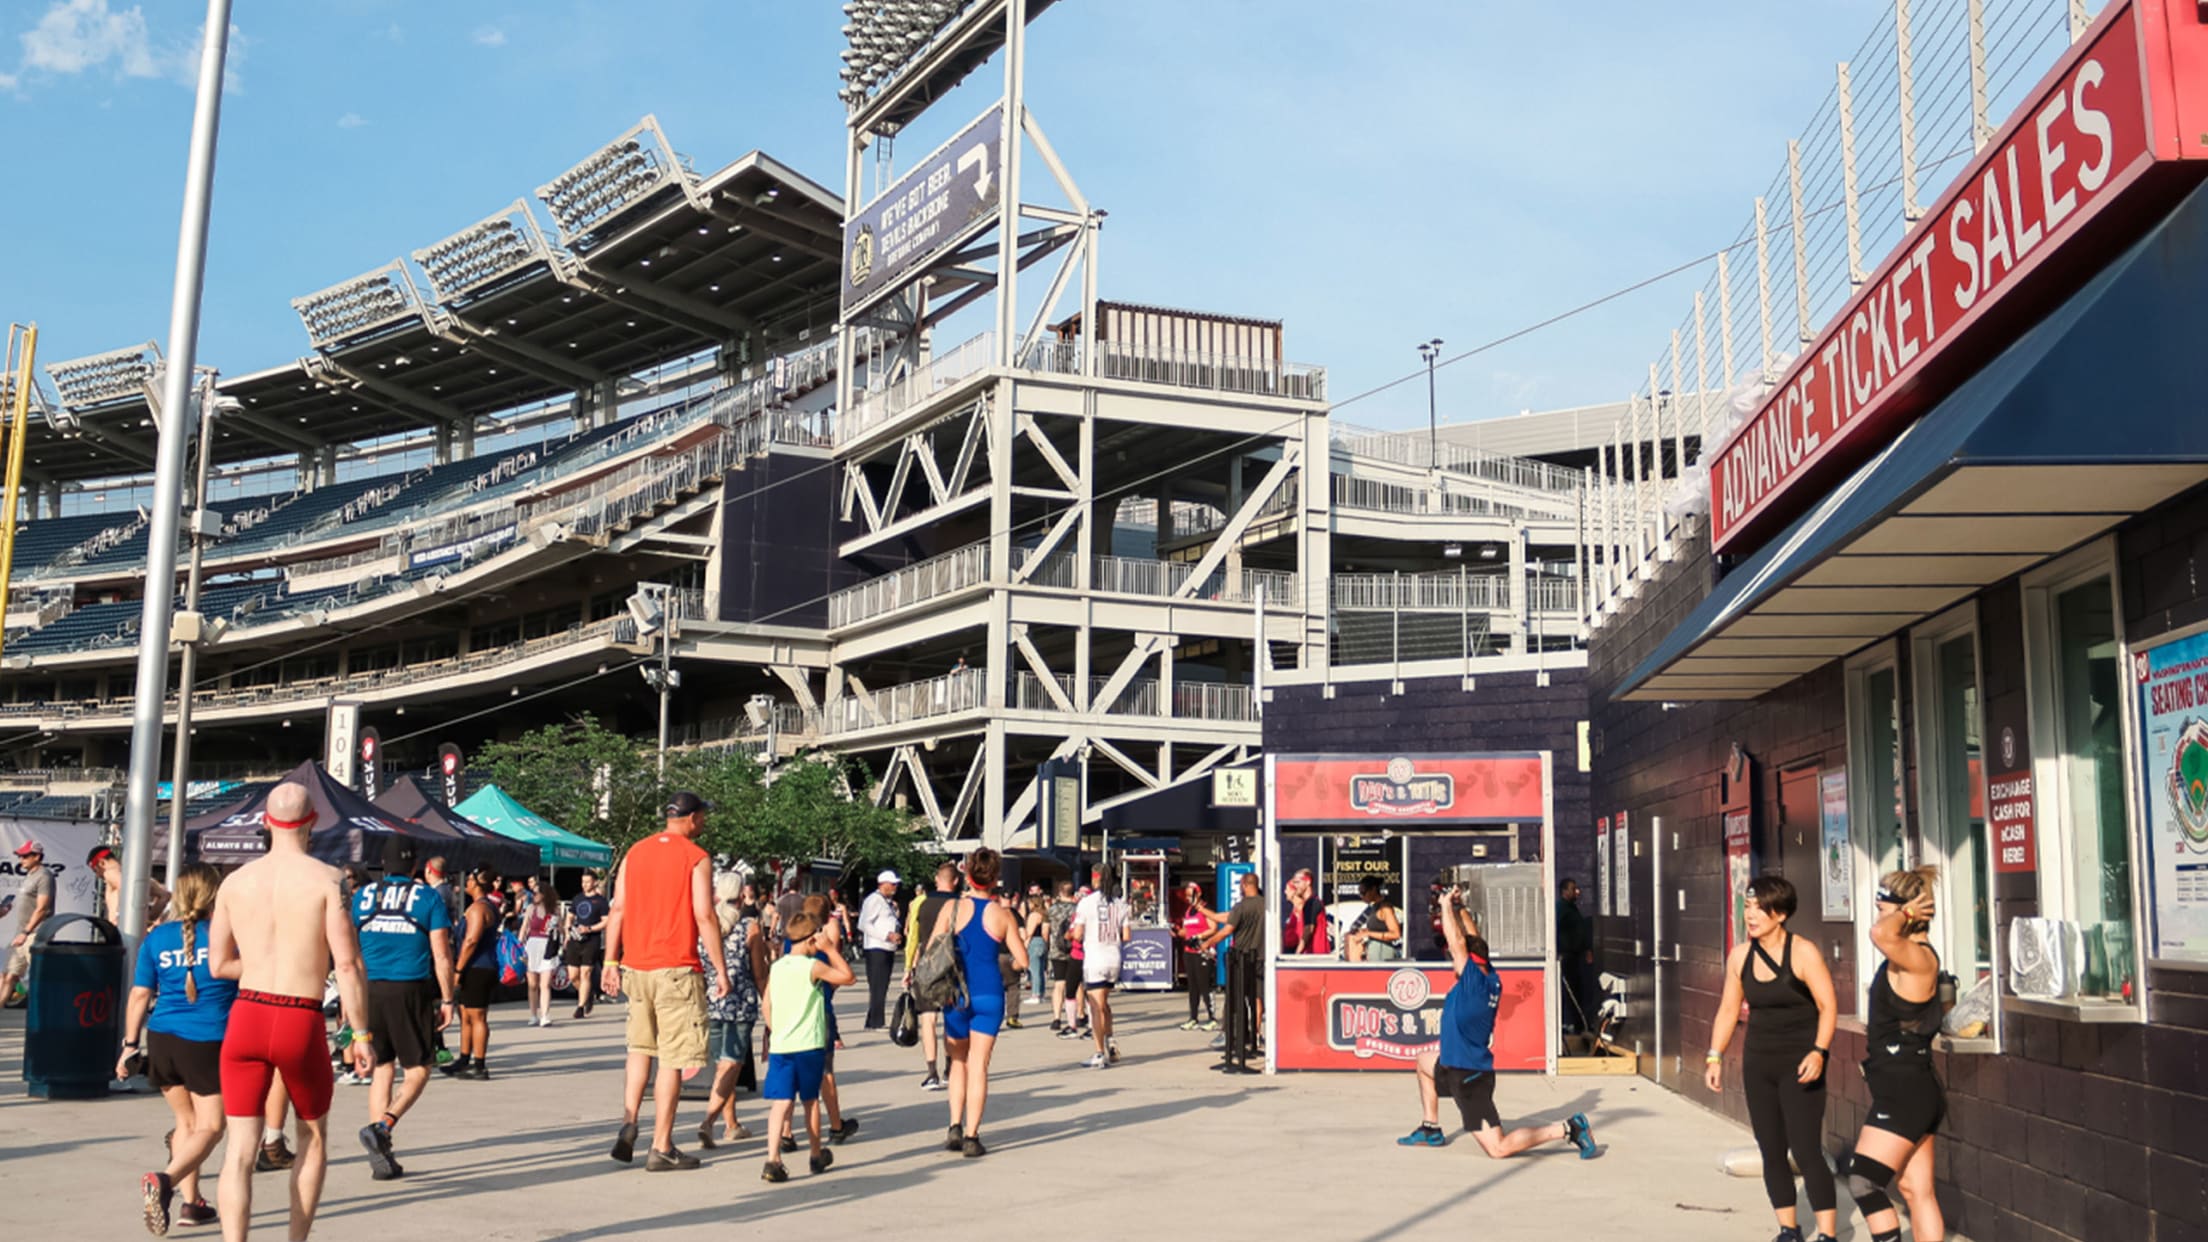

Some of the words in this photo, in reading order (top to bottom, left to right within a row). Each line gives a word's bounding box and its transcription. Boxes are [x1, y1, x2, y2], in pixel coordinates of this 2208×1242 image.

[908, 181, 926, 211] GOT
[1723, 366, 1819, 529] ADVANCE
[1823, 232, 1936, 430] TICKET
[1951, 59, 2112, 309] SALES
[2151, 676, 2193, 716] SEATING
[1991, 779, 2031, 800] EXCHANGE
[1993, 803, 2014, 821] CASH
[2015, 801, 2031, 818] FOR
[206, 842, 240, 850] ALWAYS
[243, 842, 255, 850] BE
[1364, 861, 1389, 871] OUR
[360, 882, 424, 912] SAF
[1401, 1012, 1417, 1034] &
[1365, 1039, 1401, 1054] FROZEN
